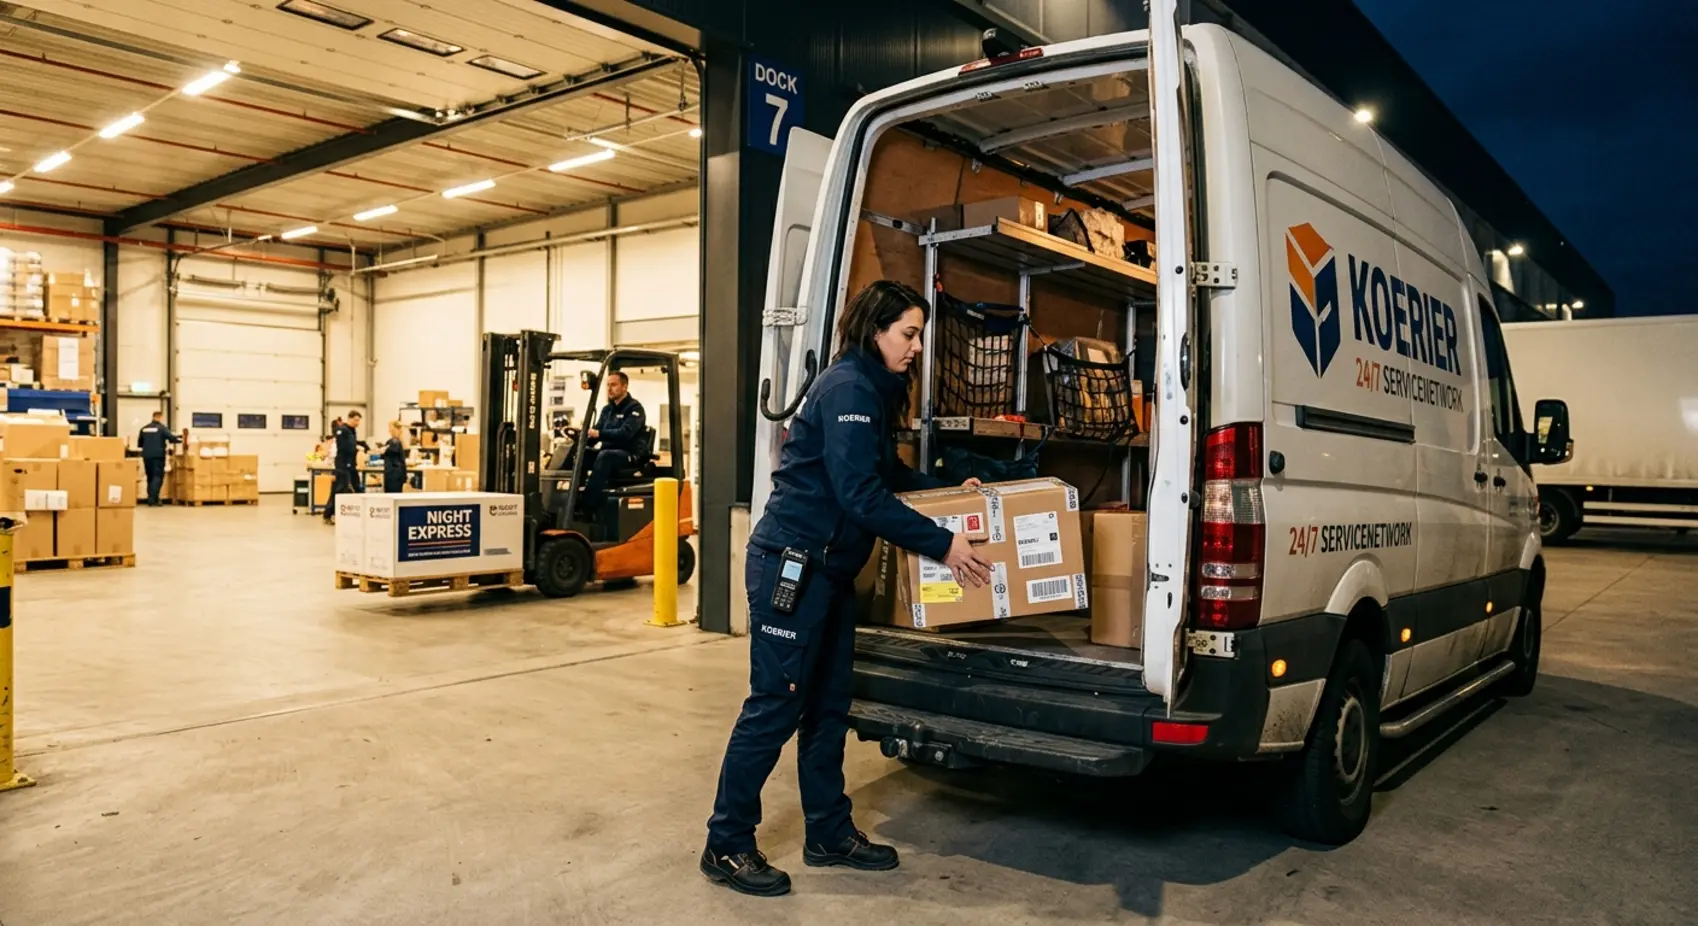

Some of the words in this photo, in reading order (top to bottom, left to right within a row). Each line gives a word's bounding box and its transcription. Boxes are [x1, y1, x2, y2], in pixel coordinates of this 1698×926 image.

[755, 62, 798, 95] DOCK
[765, 92, 789, 146] 7
[1348, 253, 1462, 377] KOERIER
[1355, 357, 1381, 393] 24/7
[1383, 364, 1464, 413] SERVICENETWORK
[408, 524, 472, 540] EXPRESS
[427, 509, 473, 524] NIGHT
[1289, 524, 1319, 558] 24/7
[1321, 521, 1412, 553] SERVICENETWORK
[761, 623, 797, 640] KOERIER
